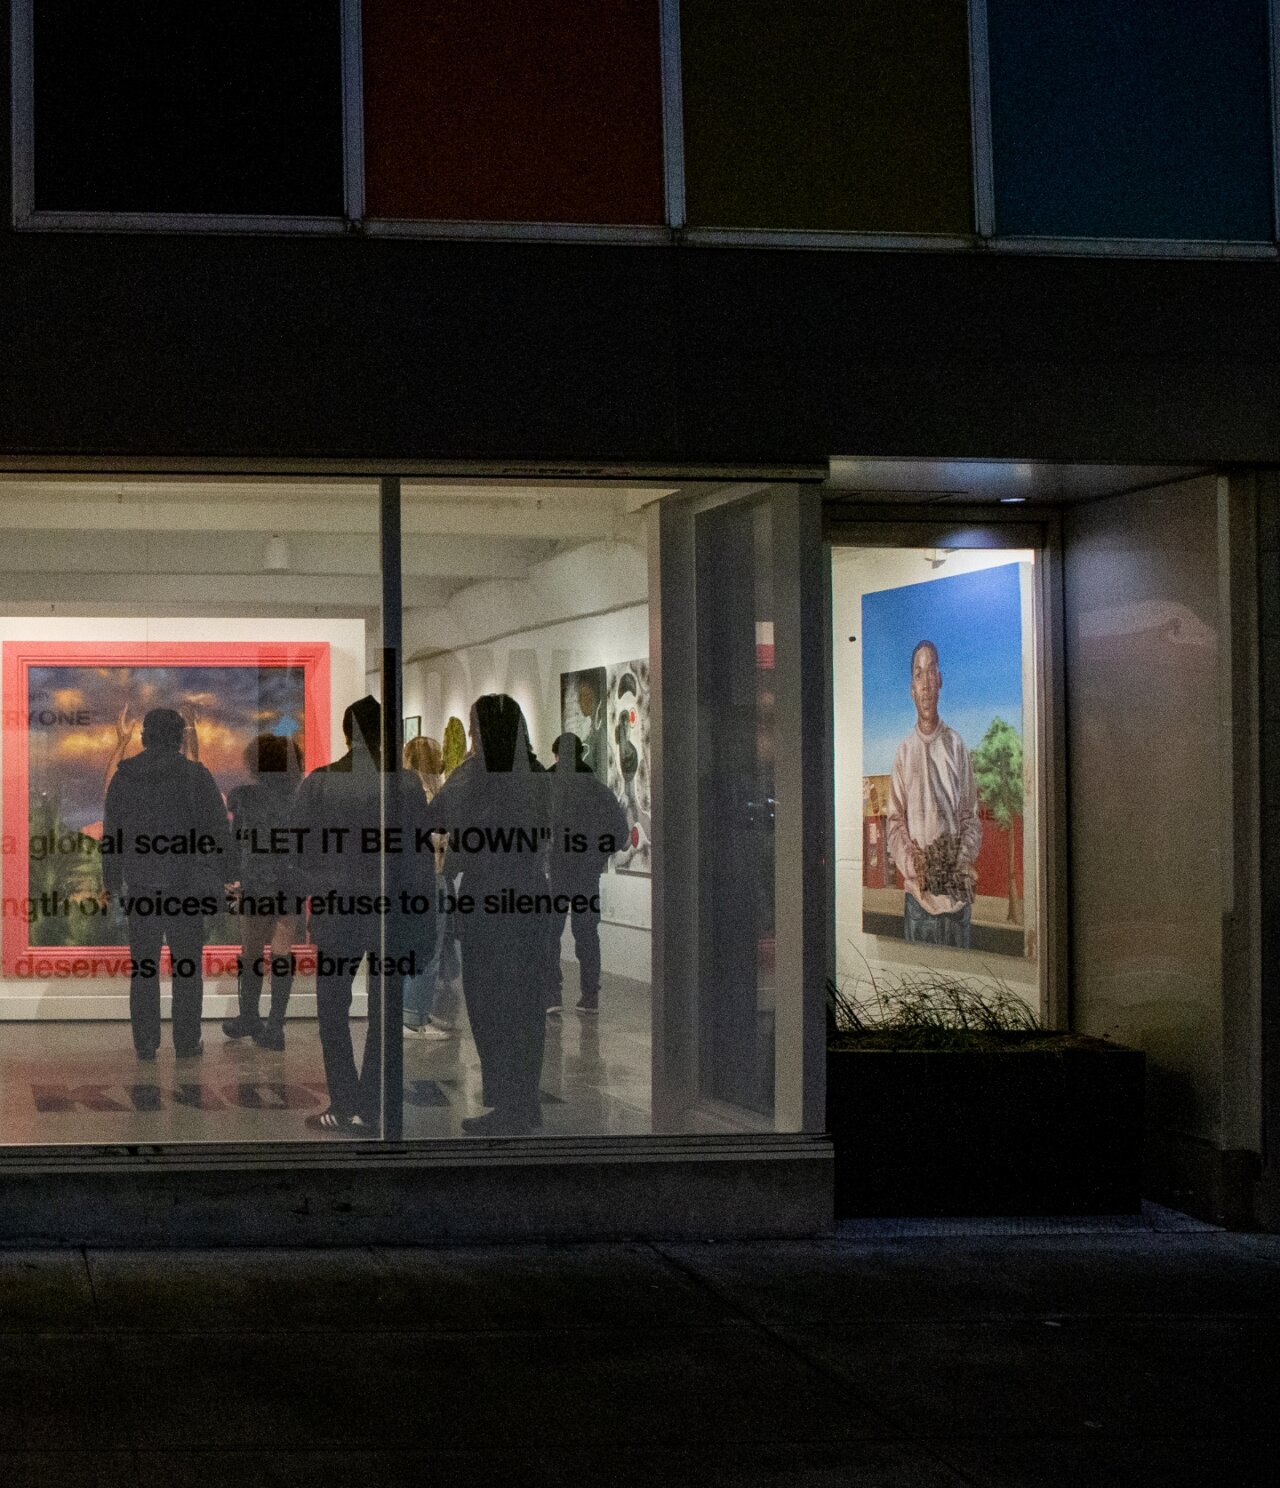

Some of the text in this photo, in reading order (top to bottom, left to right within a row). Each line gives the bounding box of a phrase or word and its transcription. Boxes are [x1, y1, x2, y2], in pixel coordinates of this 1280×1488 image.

[1, 834, 17, 855] a
[28, 828, 123, 861] global
[135, 828, 223, 855] scale.
[322, 827, 350, 854] IT
[361, 827, 403, 853] BE
[563, 828, 587, 853] is
[597, 832, 615, 853] a
[120, 890, 218, 917] voices
[226, 889, 287, 916] that
[295, 890, 391, 915] refuse
[400, 890, 429, 914] to
[438, 888, 475, 914] be
[15, 953, 157, 979] deserves
[167, 954, 196, 979] to
[205, 953, 244, 977] be
